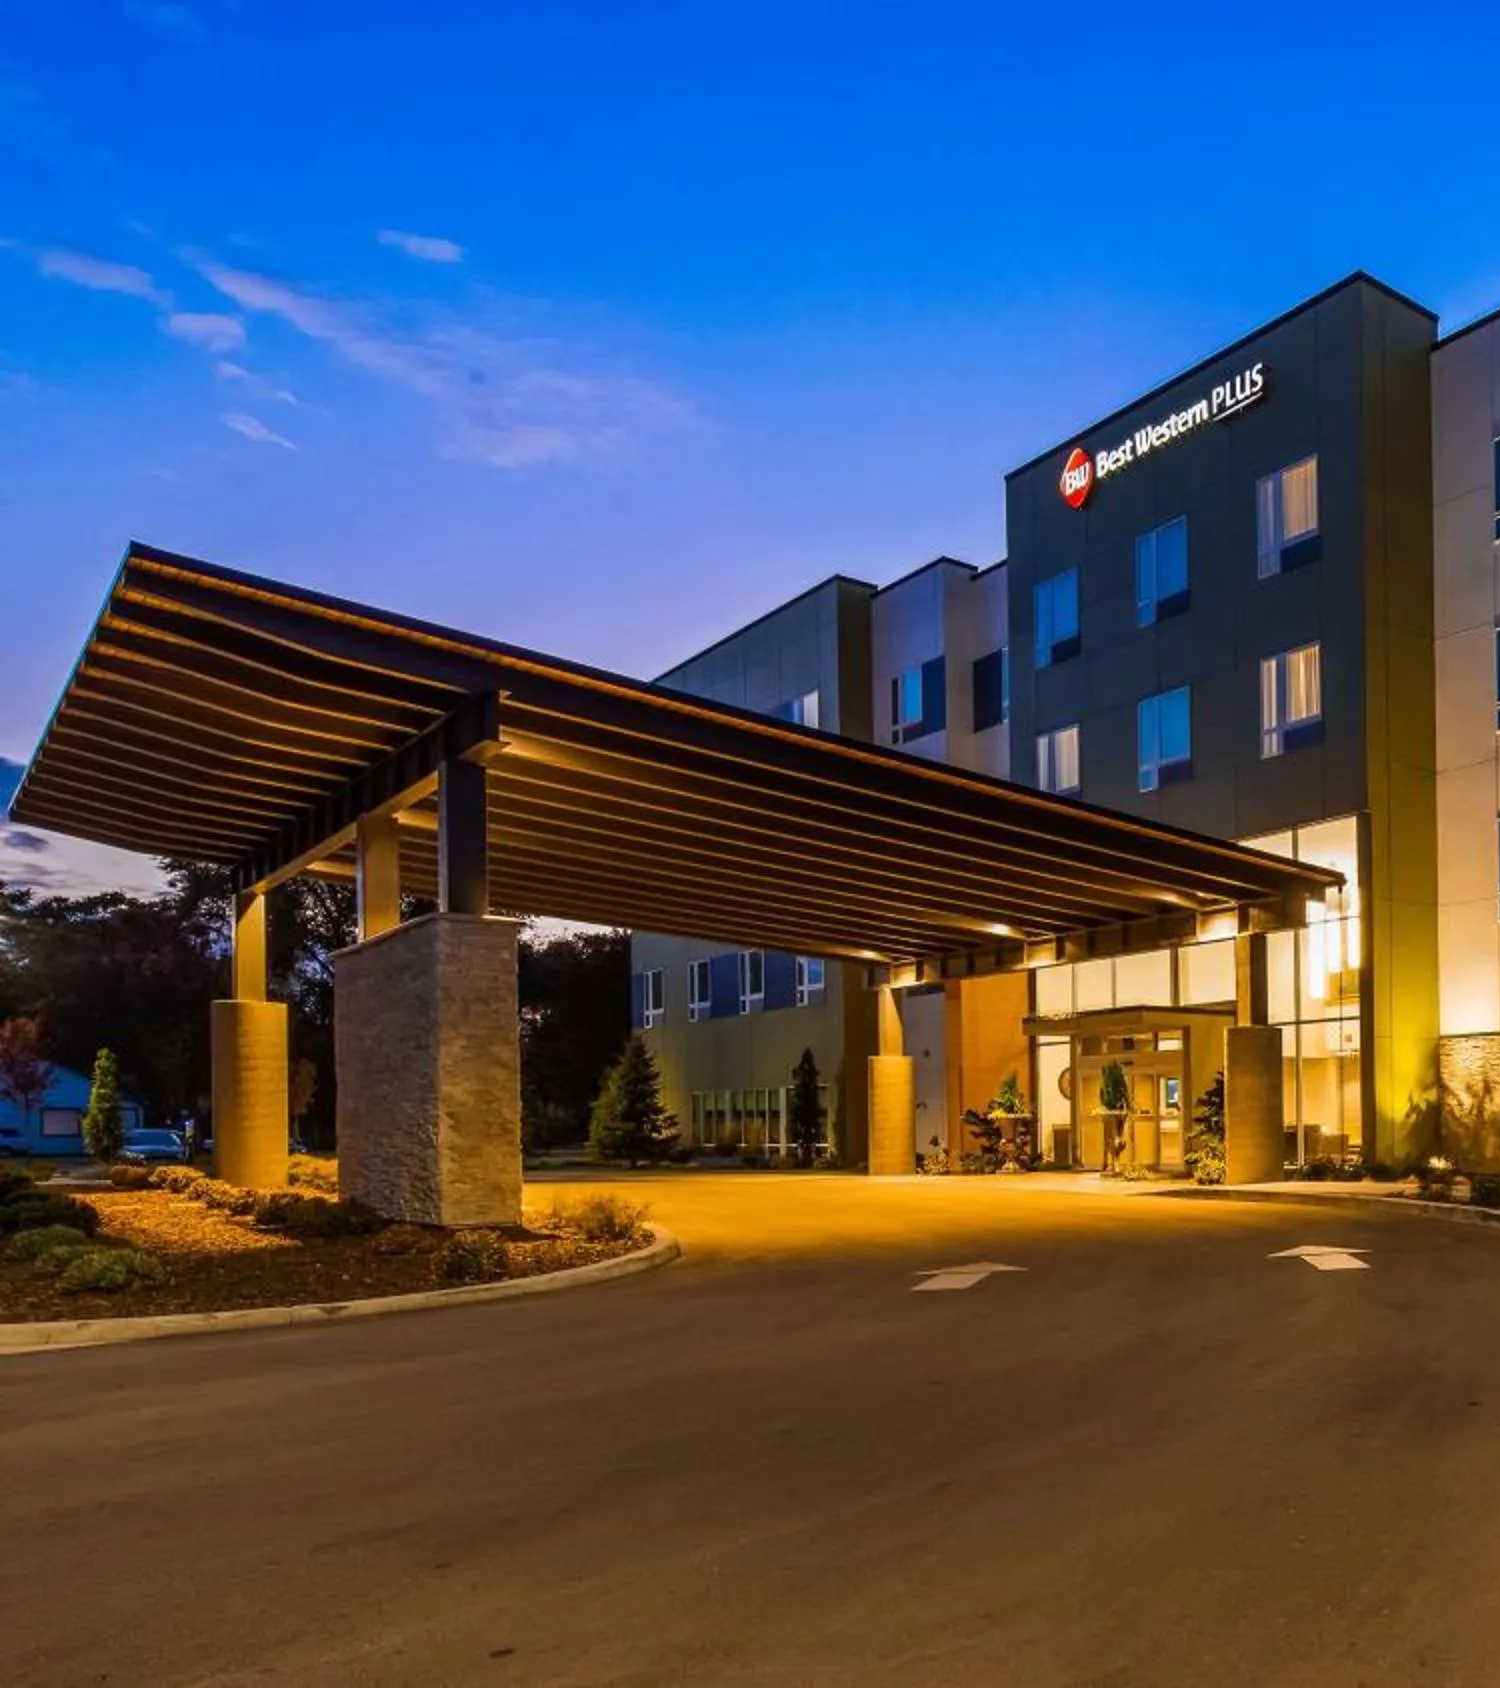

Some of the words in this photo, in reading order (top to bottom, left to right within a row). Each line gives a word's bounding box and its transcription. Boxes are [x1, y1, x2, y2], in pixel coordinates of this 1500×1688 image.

[1096, 439, 1133, 478] Best
[1134, 400, 1209, 456] Western
[1212, 362, 1264, 414] PLUS
[1065, 462, 1089, 496] BW
